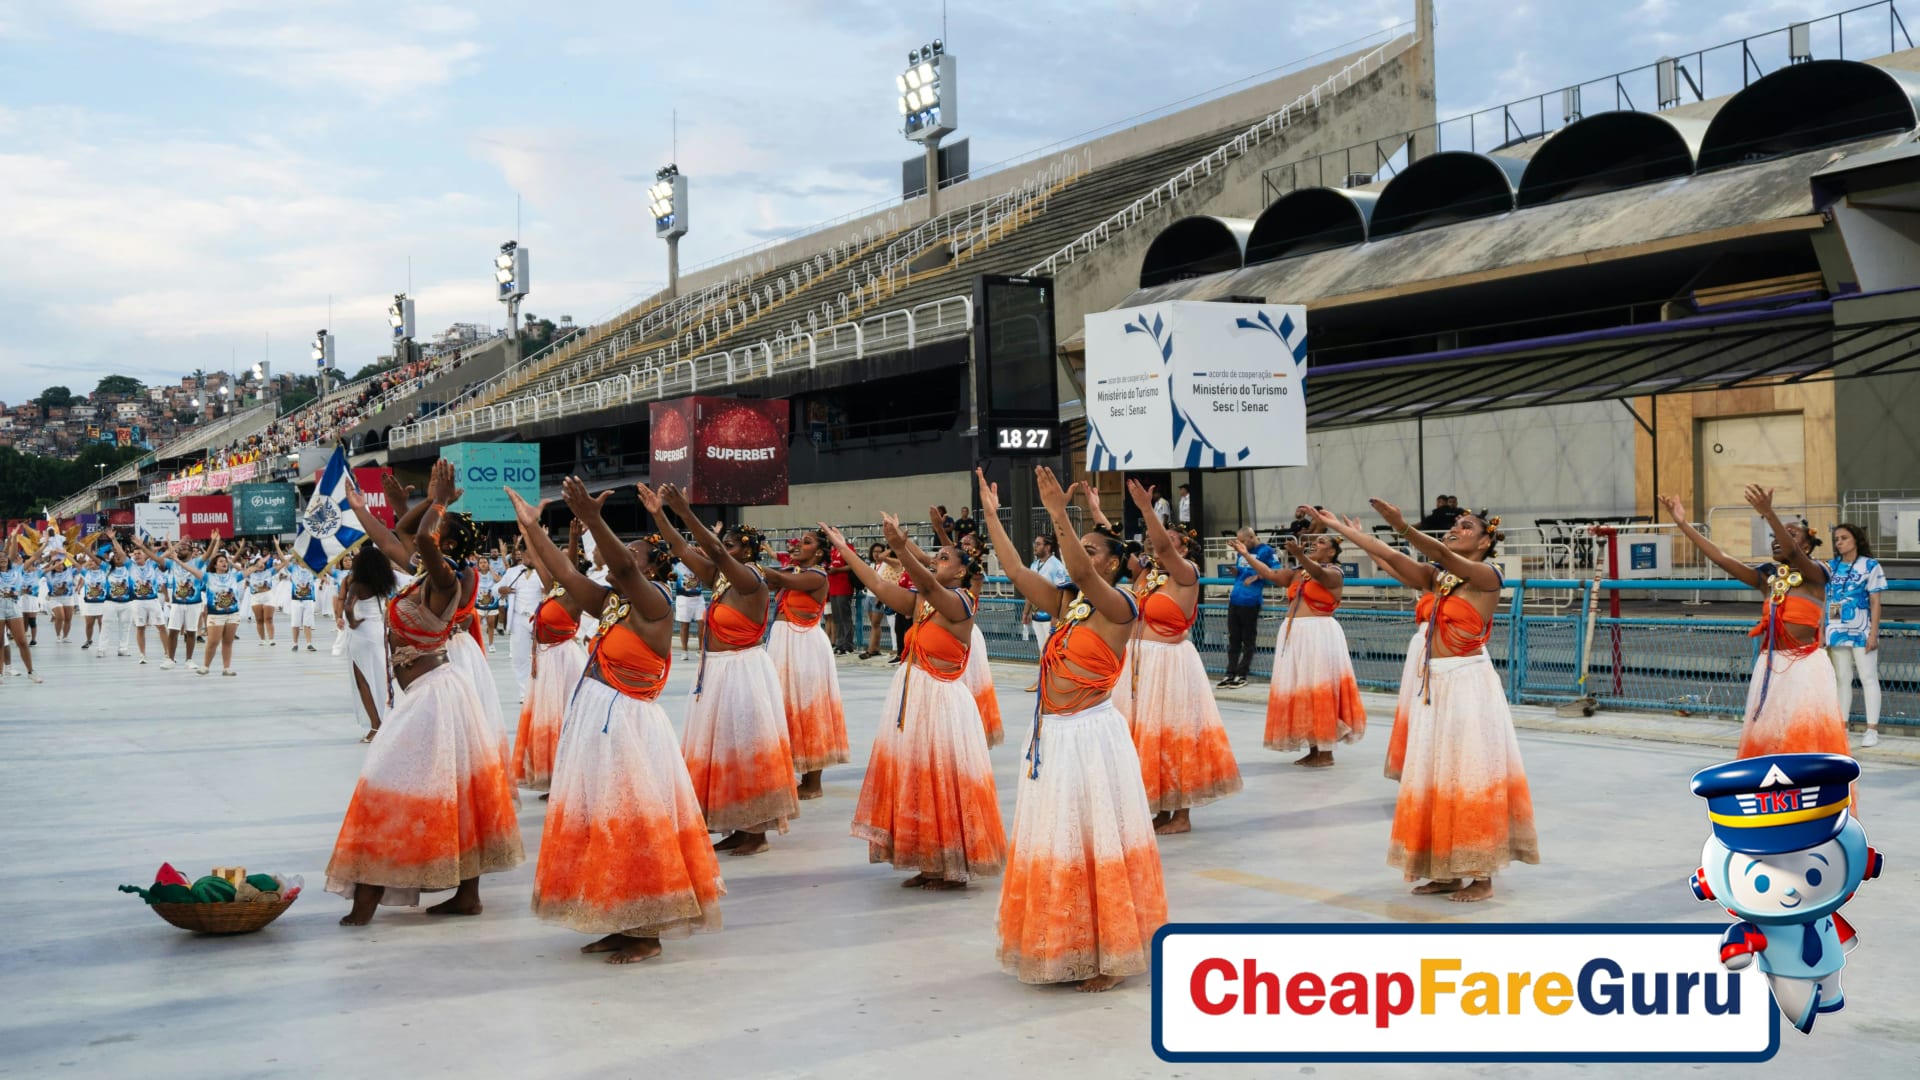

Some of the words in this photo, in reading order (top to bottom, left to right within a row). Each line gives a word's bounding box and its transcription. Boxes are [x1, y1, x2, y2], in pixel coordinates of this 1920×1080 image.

[1230, 370, 1237, 378] de
[1097, 388, 1127, 401] Ministério
[1128, 389, 1135, 399] do
[1136, 387, 1159, 398] Turismo
[1192, 383, 1238, 395] Ministério
[1240, 384, 1250, 395] do
[1252, 384, 1288, 395] Turismo
[1110, 406, 1125, 417] Sesc
[1128, 404, 1147, 415] Senac
[1212, 400, 1235, 412] Sesc
[1241, 400, 1269, 412] Senac
[999, 429, 1023, 449] 18
[1026, 429, 1049, 449] 27
[654, 446, 688, 462] SUPERBET
[706, 446, 776, 461] SUPERBET
[503, 467, 536, 482] RIO
[264, 496, 286, 507] Light
[191, 512, 229, 524] BRAHMA
